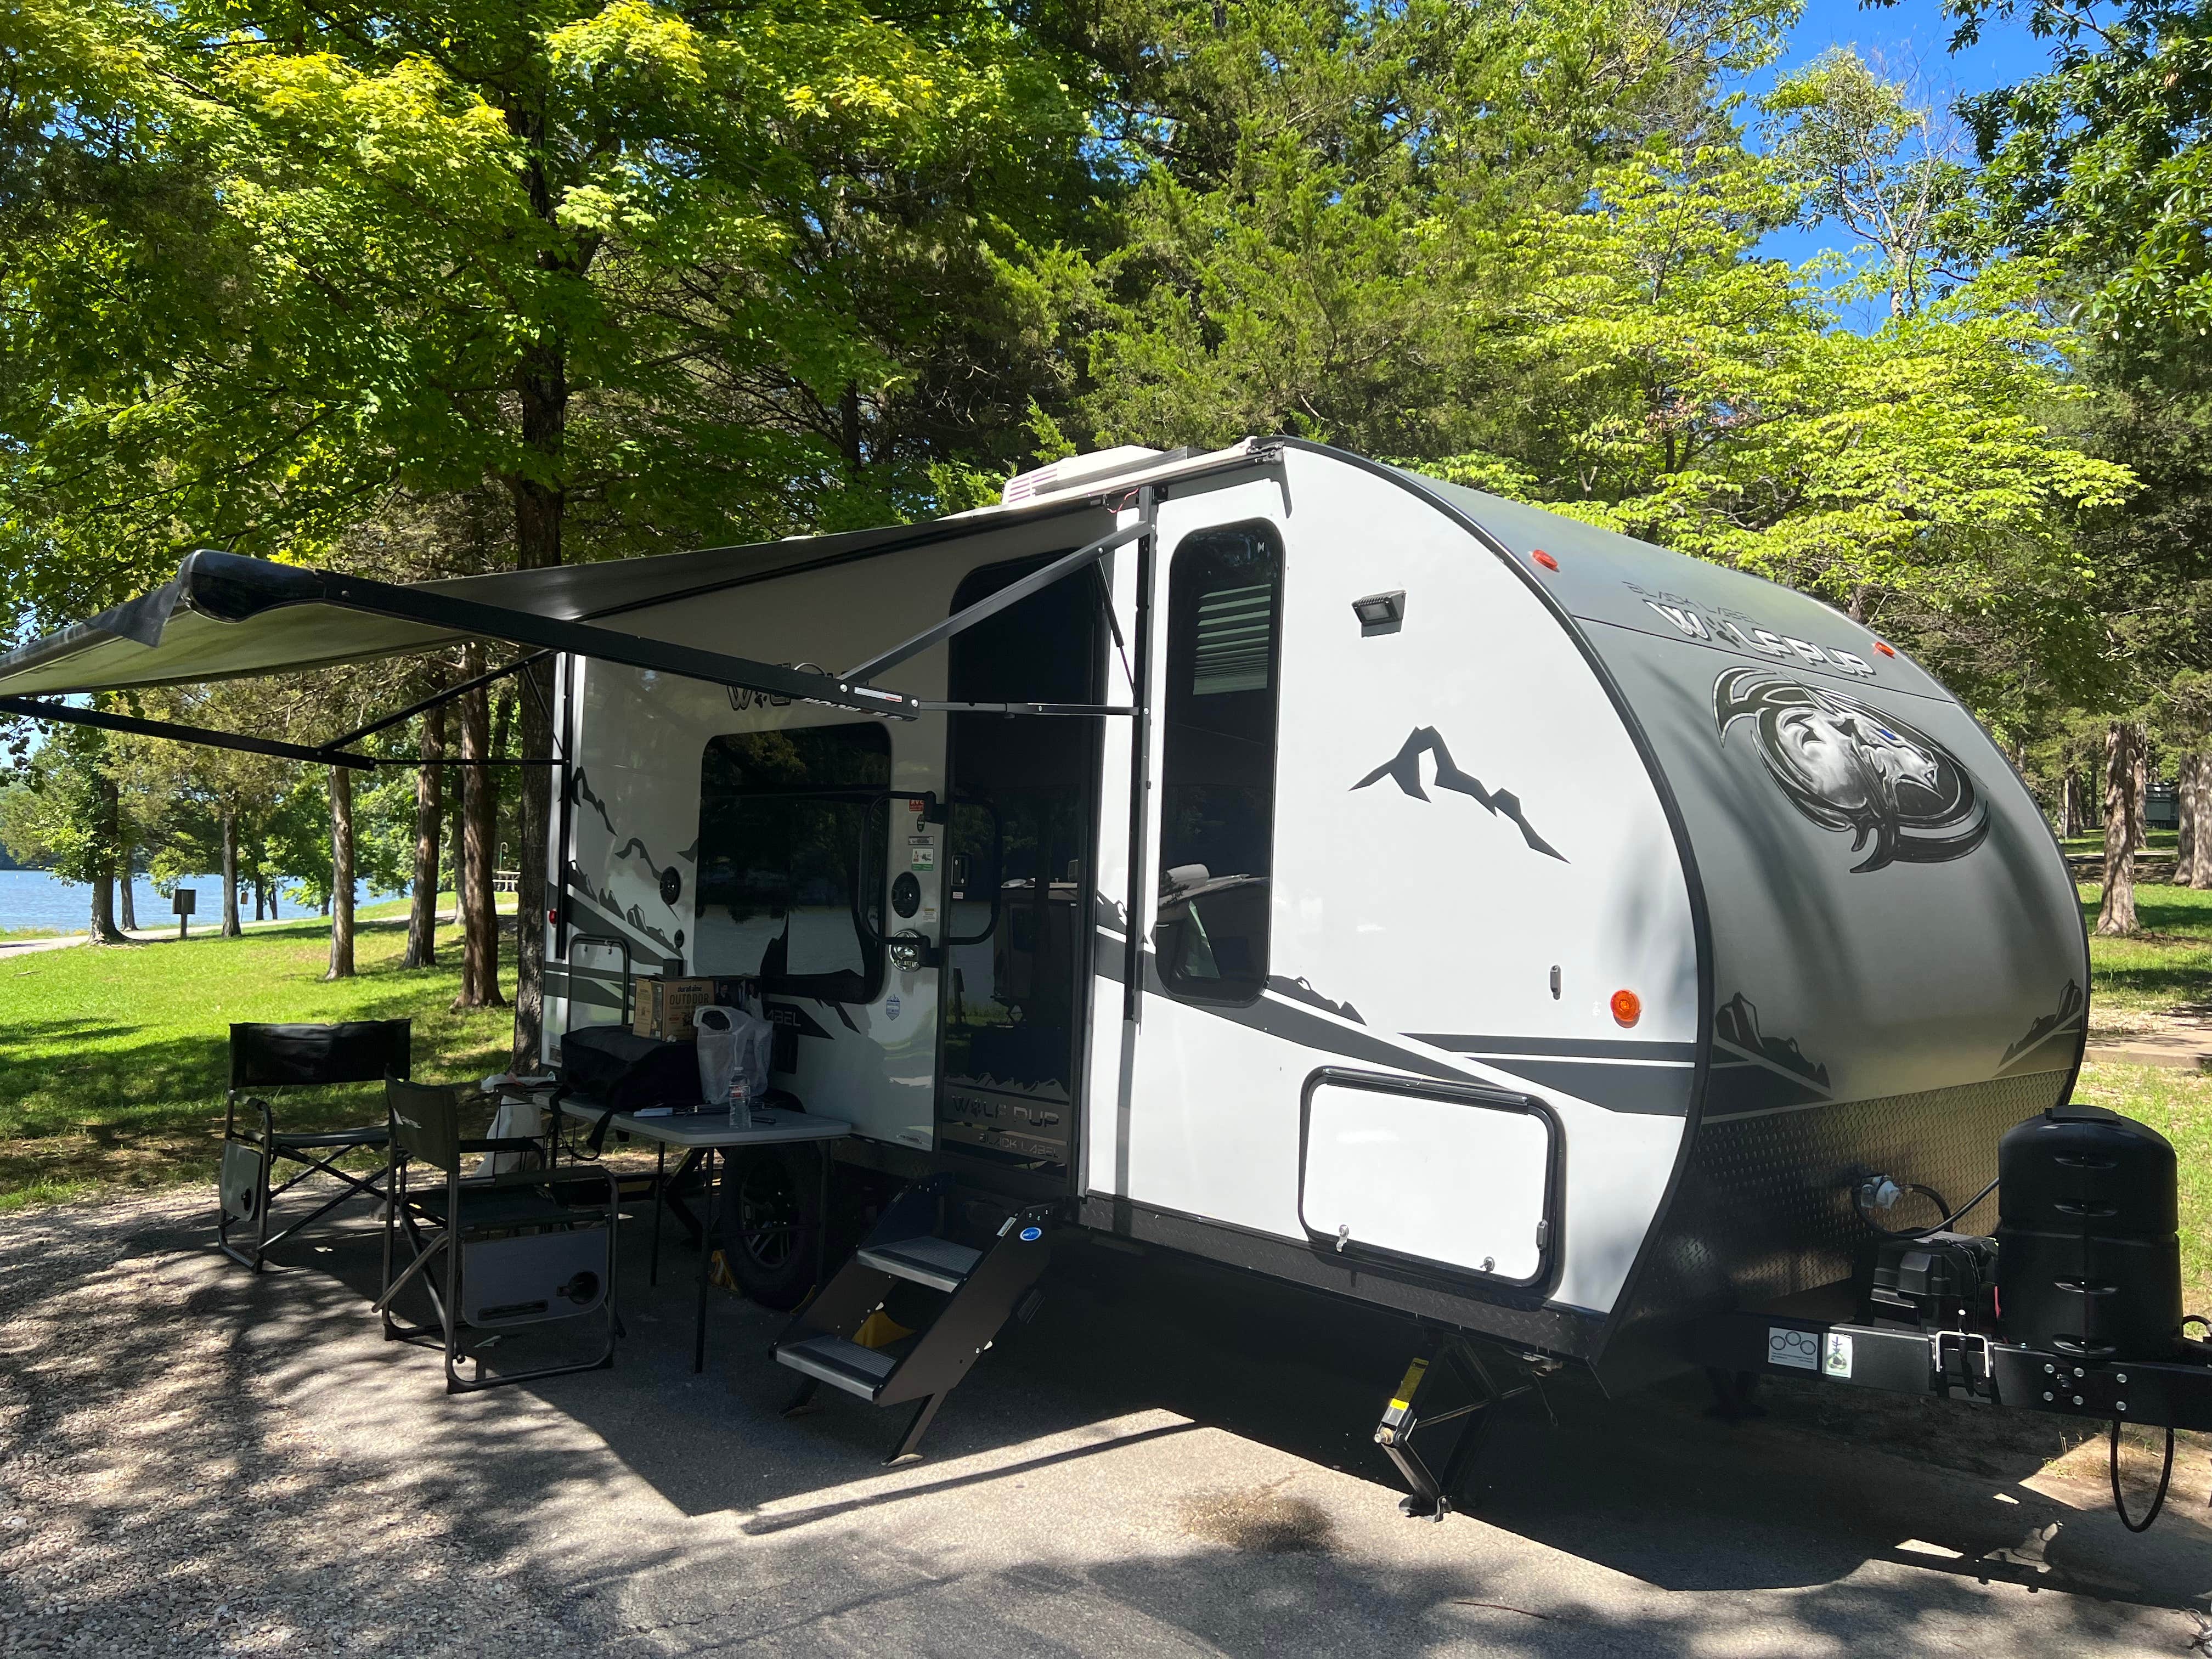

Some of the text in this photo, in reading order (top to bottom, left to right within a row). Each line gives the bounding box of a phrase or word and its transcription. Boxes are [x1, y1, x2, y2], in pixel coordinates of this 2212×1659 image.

[670, 993, 709, 1005] OUTDOOR
[767, 1009, 802, 1026] ABEL
[1013, 1106, 1059, 1127] PUP
[978, 1133, 1060, 1159] BLACK LABEL
